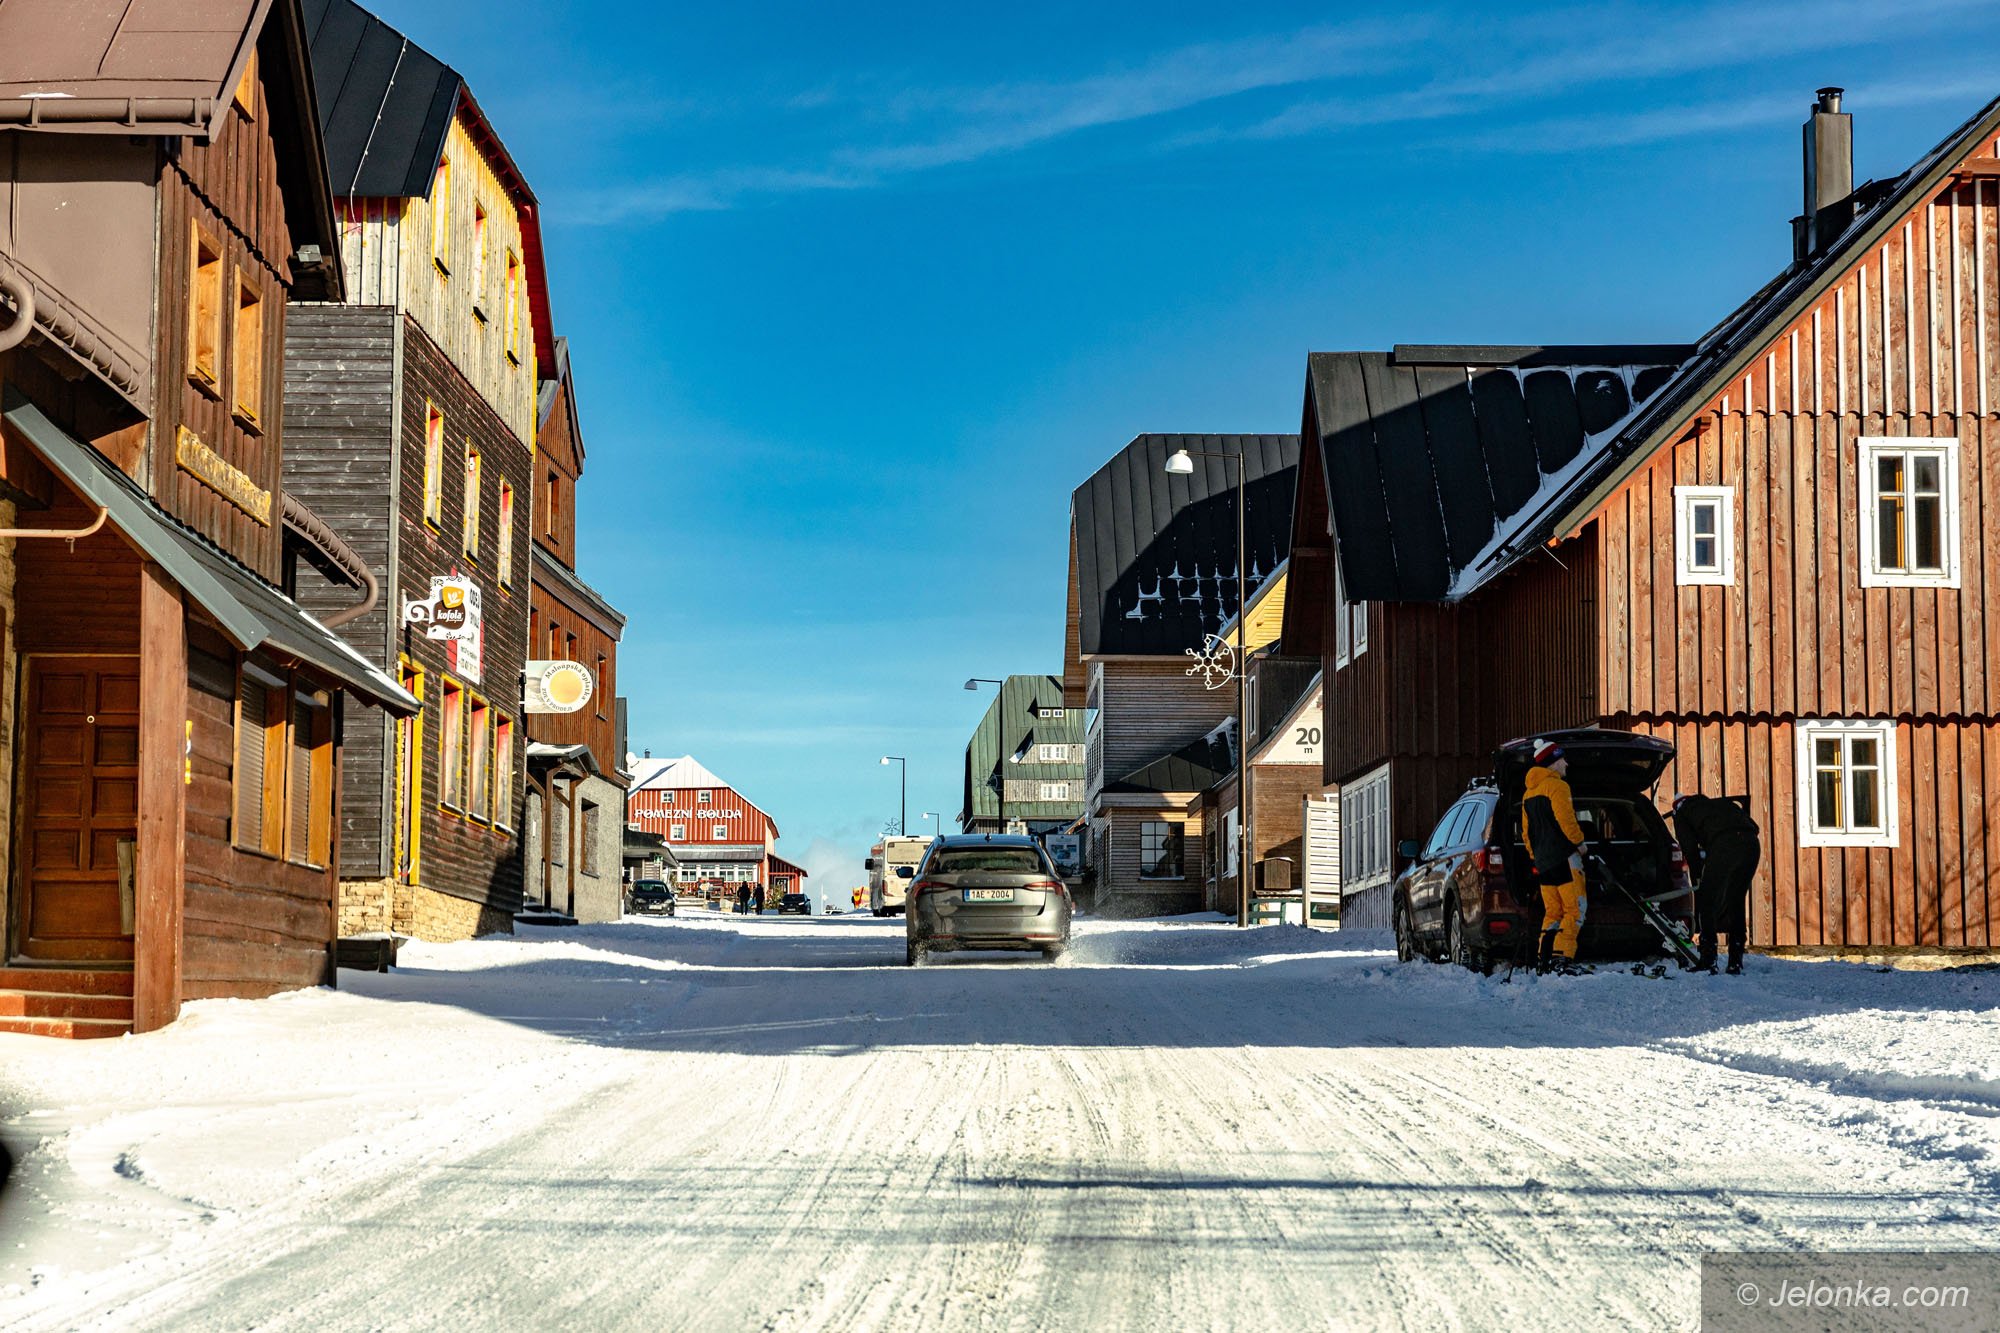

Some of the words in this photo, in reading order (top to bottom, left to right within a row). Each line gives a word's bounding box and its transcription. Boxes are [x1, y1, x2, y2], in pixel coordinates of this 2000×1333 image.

[436, 609, 463, 623] kofola
[1296, 727, 1321, 745] 20
[634, 806, 693, 819] POMEZNÍ
[696, 809, 742, 819] BOUDA
[971, 890, 985, 899] 1AE
